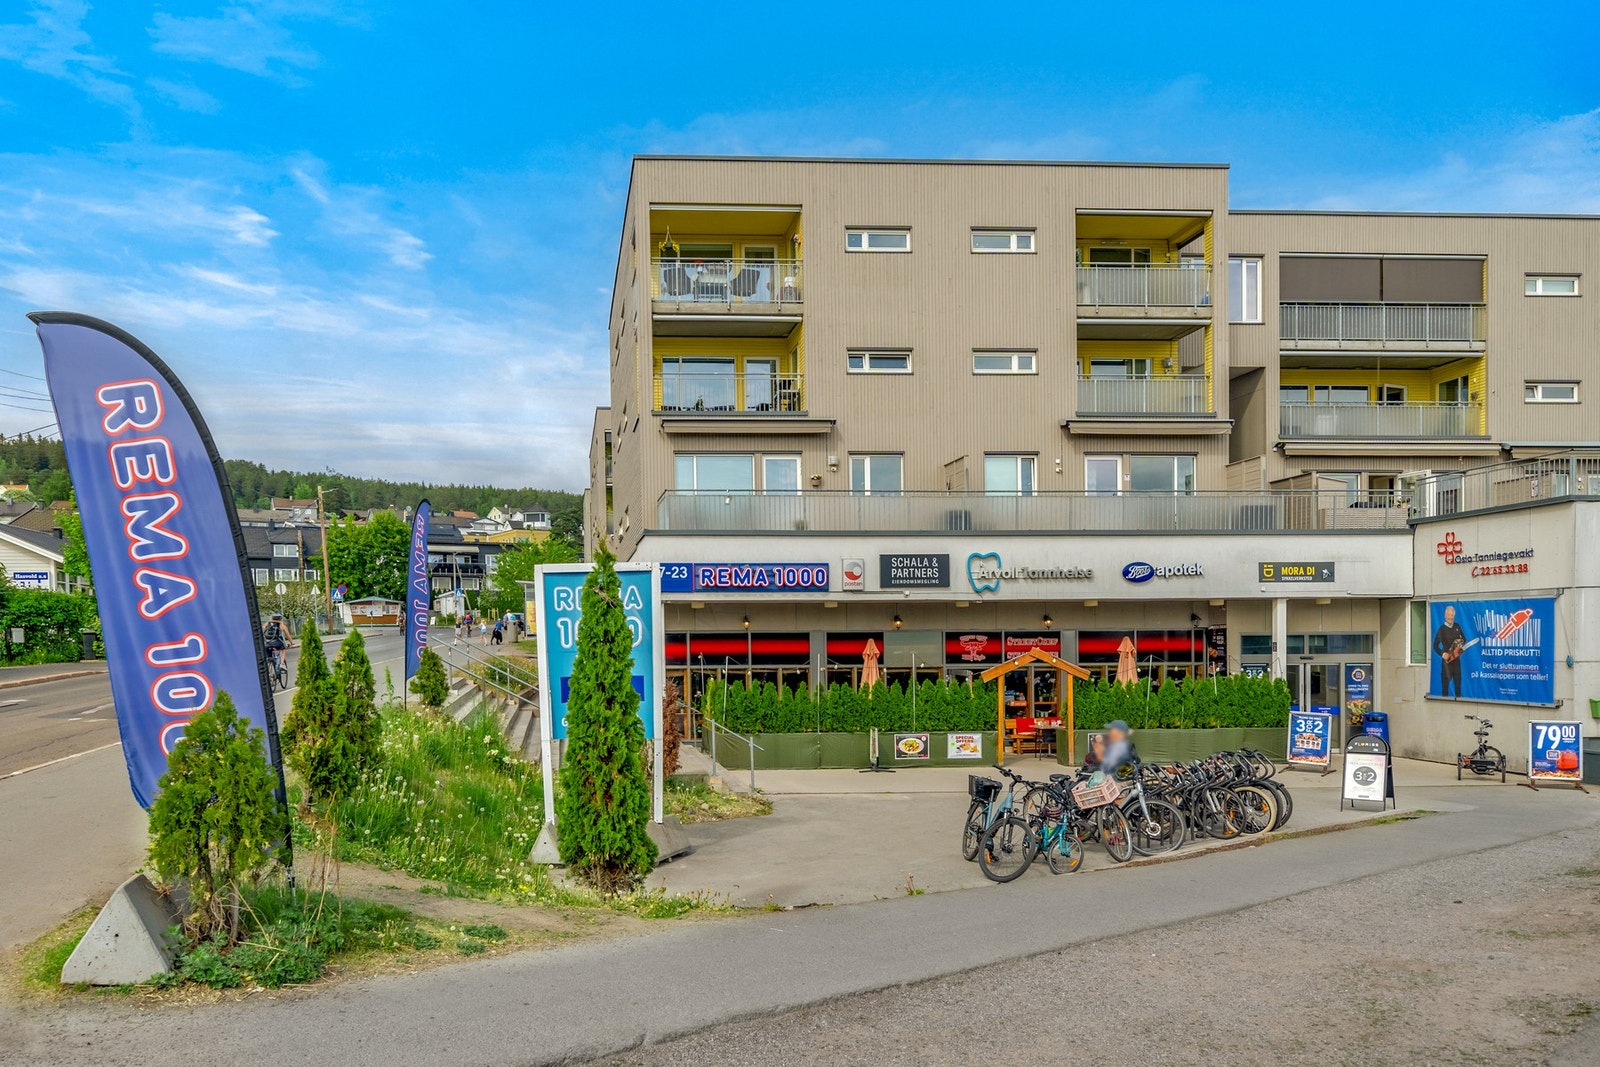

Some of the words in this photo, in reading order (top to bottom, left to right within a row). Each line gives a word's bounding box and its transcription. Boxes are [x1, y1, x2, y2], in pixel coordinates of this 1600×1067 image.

[96, 378, 198, 621] REMA
[891, 557, 929, 567] SCHALA
[931, 557, 938, 567] &
[1455, 555, 1473, 564] Oslo
[1474, 548, 1534, 562] Tannlegevakt
[891, 568, 939, 578] PARTNERS
[1021, 566, 1094, 580] Tannhelse
[1126, 565, 1151, 579] Boots
[1156, 563, 1204, 578] apotek
[1281, 566, 1305, 576] MORA
[1306, 566, 1316, 576] DI
[1480, 566, 1490, 576] 22
[1505, 564, 1515, 574] 33
[1518, 563, 1528, 573] 88
[699, 567, 769, 588] REMA
[774, 567, 828, 587] 1000
[553, 585, 643, 611] RA
[1504, 649, 1540, 657] PRISKUTT!
[1296, 720, 1305, 732] 3
[1314, 721, 1323, 734] 2
[1355, 771, 1363, 781] 3
